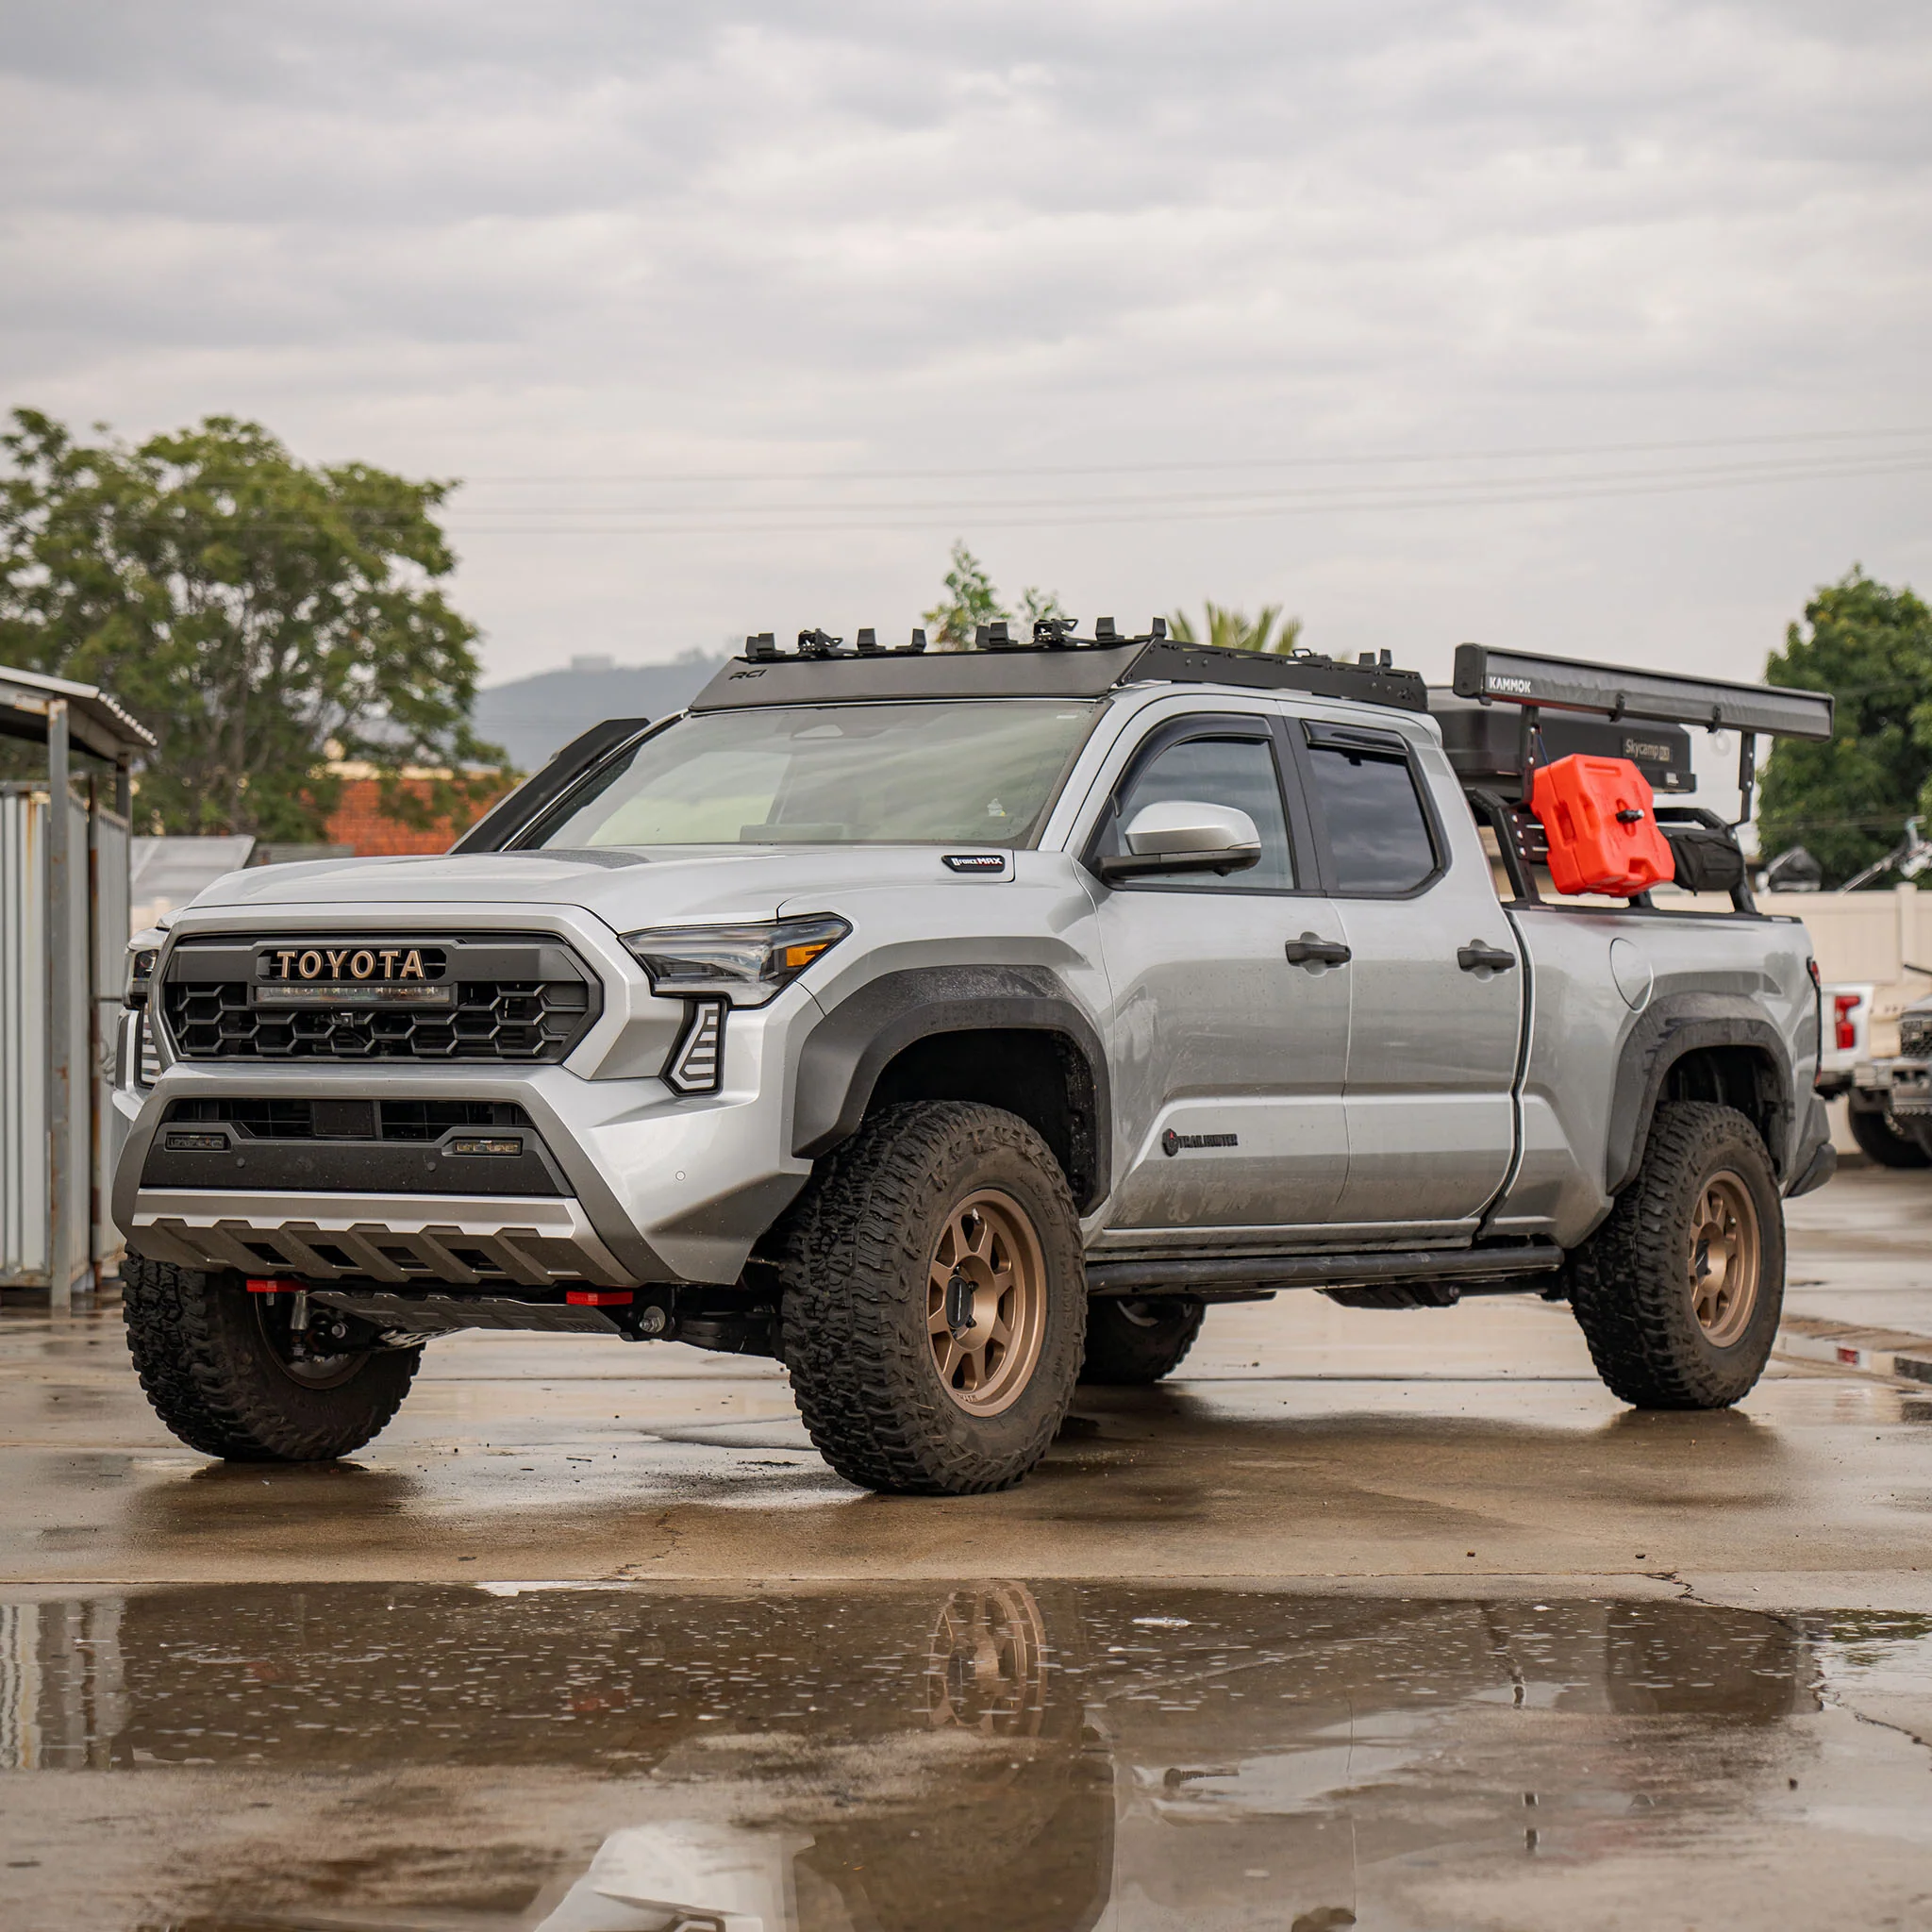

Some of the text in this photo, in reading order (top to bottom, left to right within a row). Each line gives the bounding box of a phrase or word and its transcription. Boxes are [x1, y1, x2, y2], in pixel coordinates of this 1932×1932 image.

[728, 669, 768, 680] RCI
[1489, 675, 1531, 693] KAMMOK
[1625, 739, 1659, 759] Skycamp
[276, 950, 424, 979] TOYOTA
